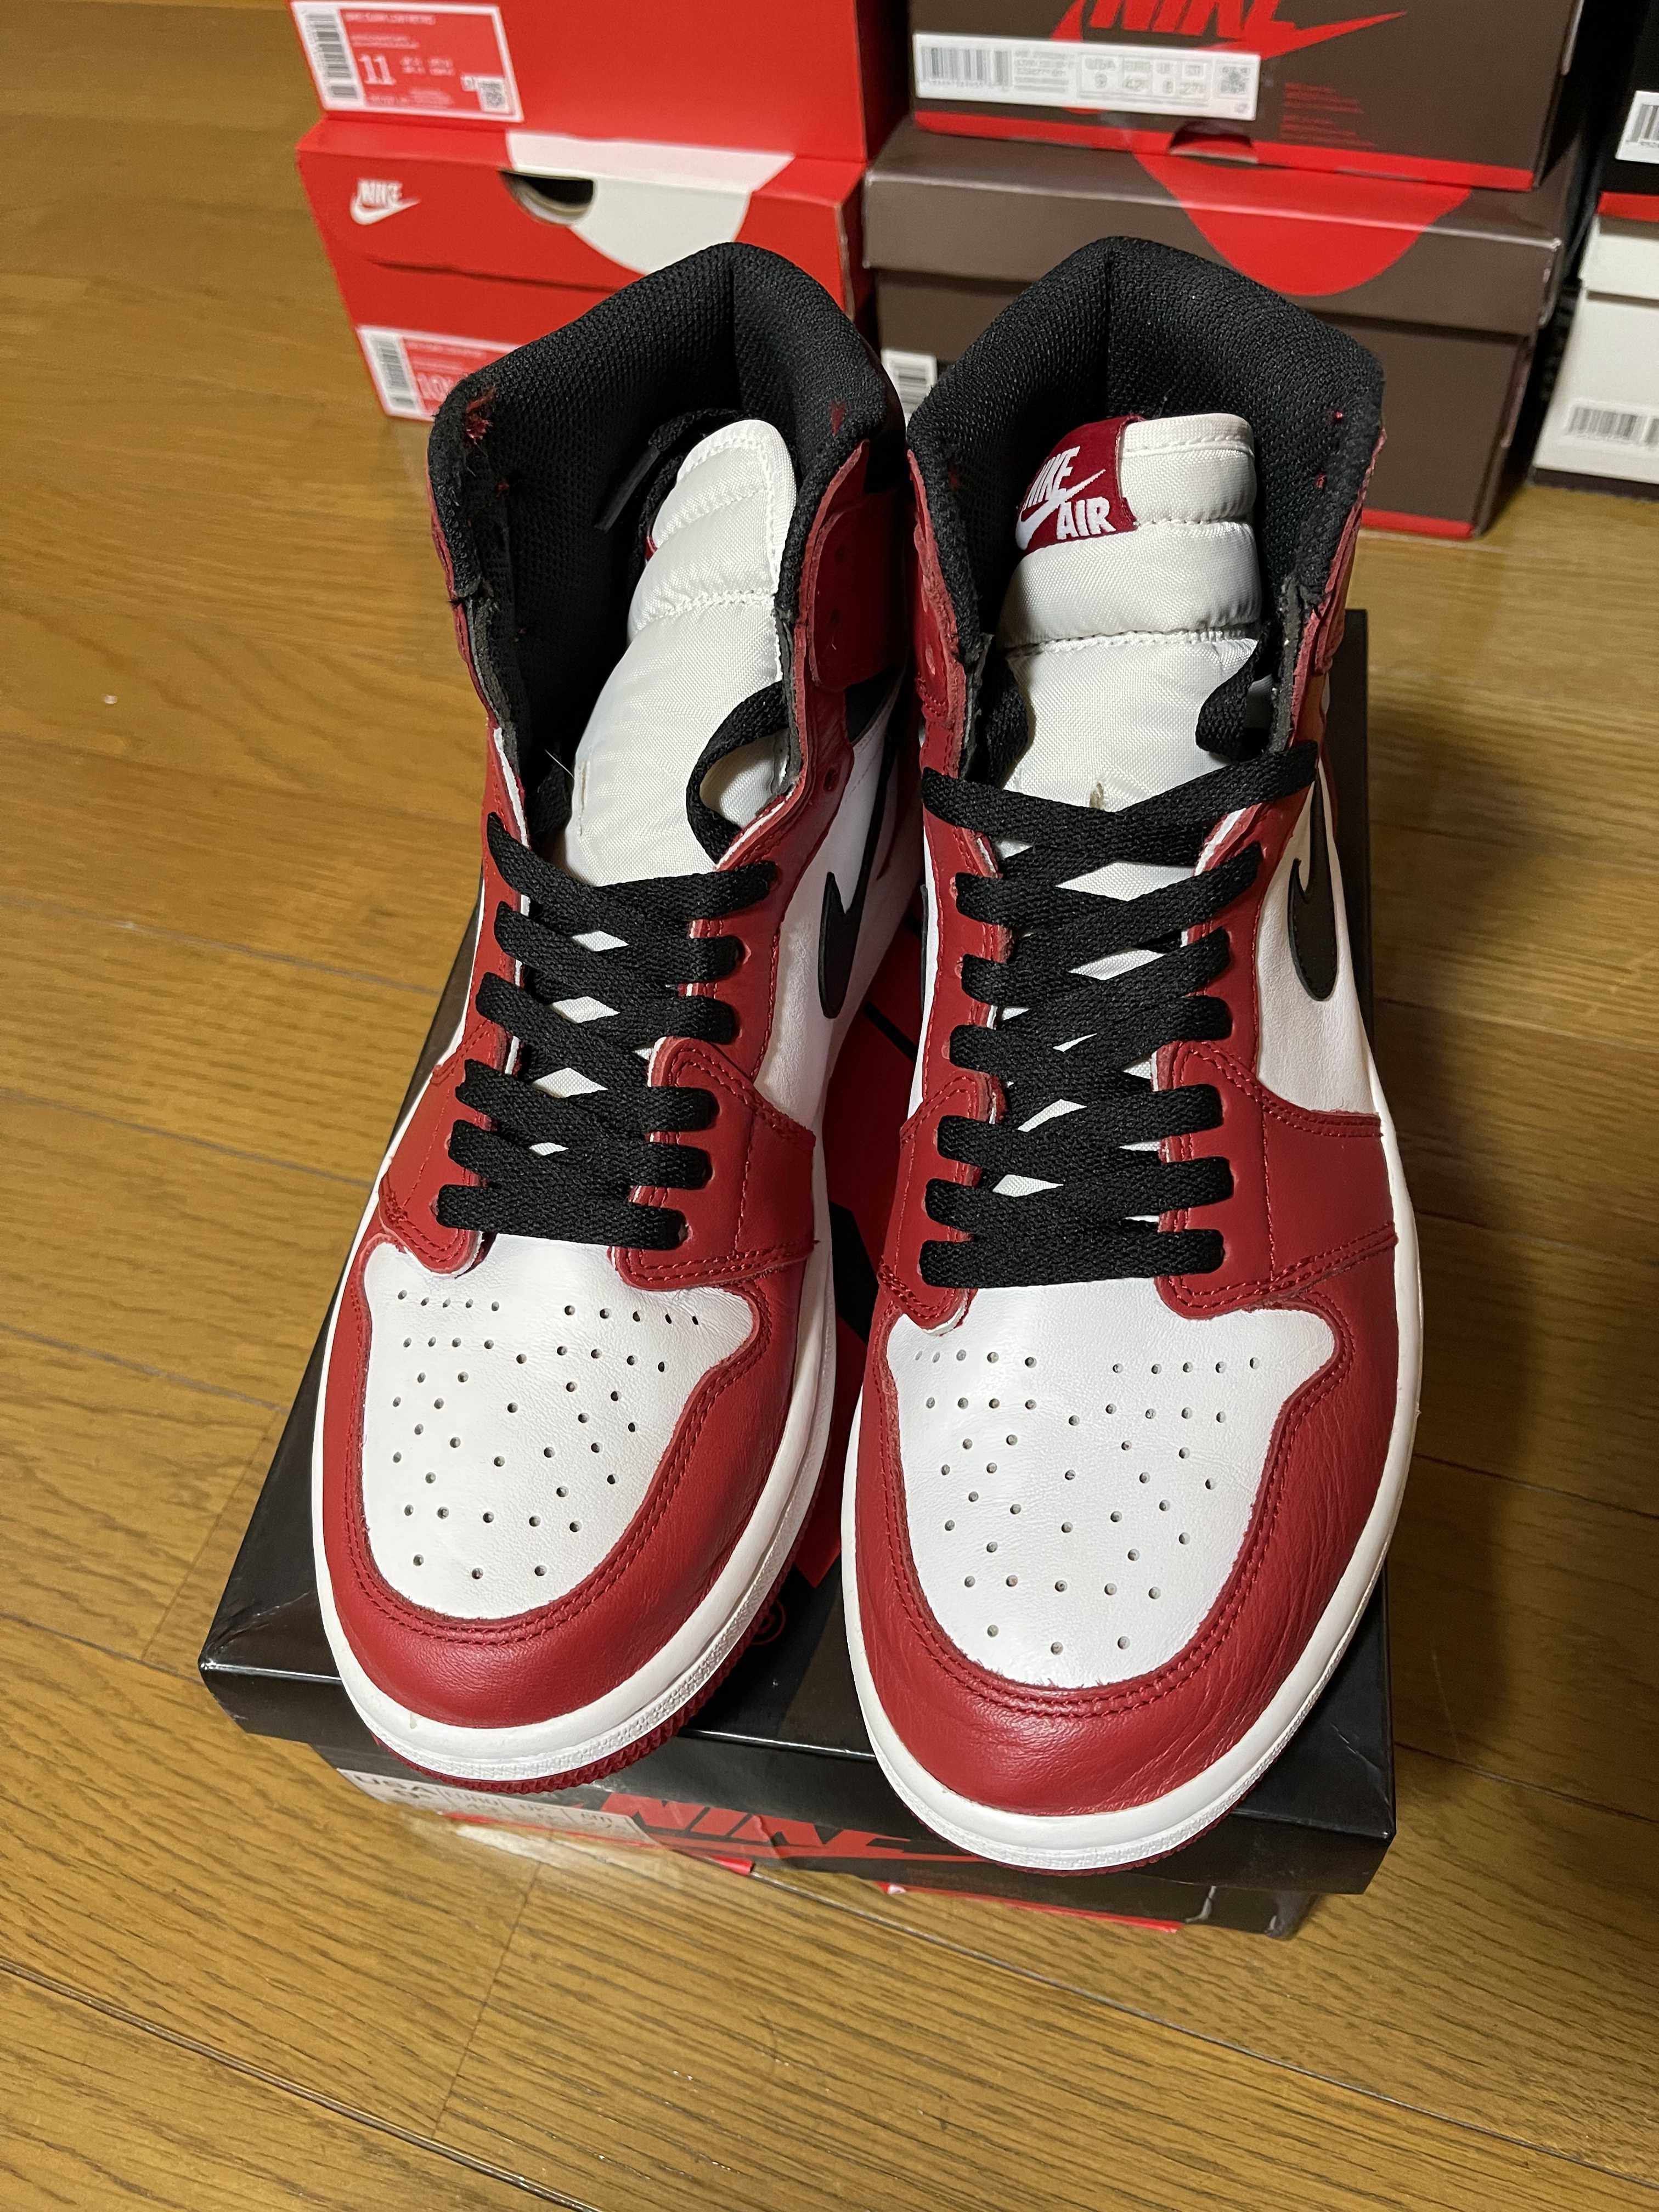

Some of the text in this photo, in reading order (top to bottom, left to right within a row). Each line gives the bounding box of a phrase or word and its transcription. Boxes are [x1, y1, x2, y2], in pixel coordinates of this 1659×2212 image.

[358, 54, 397, 85] 11
[357, 178, 403, 208] NIKE
[1022, 445, 1080, 511] NIKE
[1057, 497, 1116, 540] AIR
